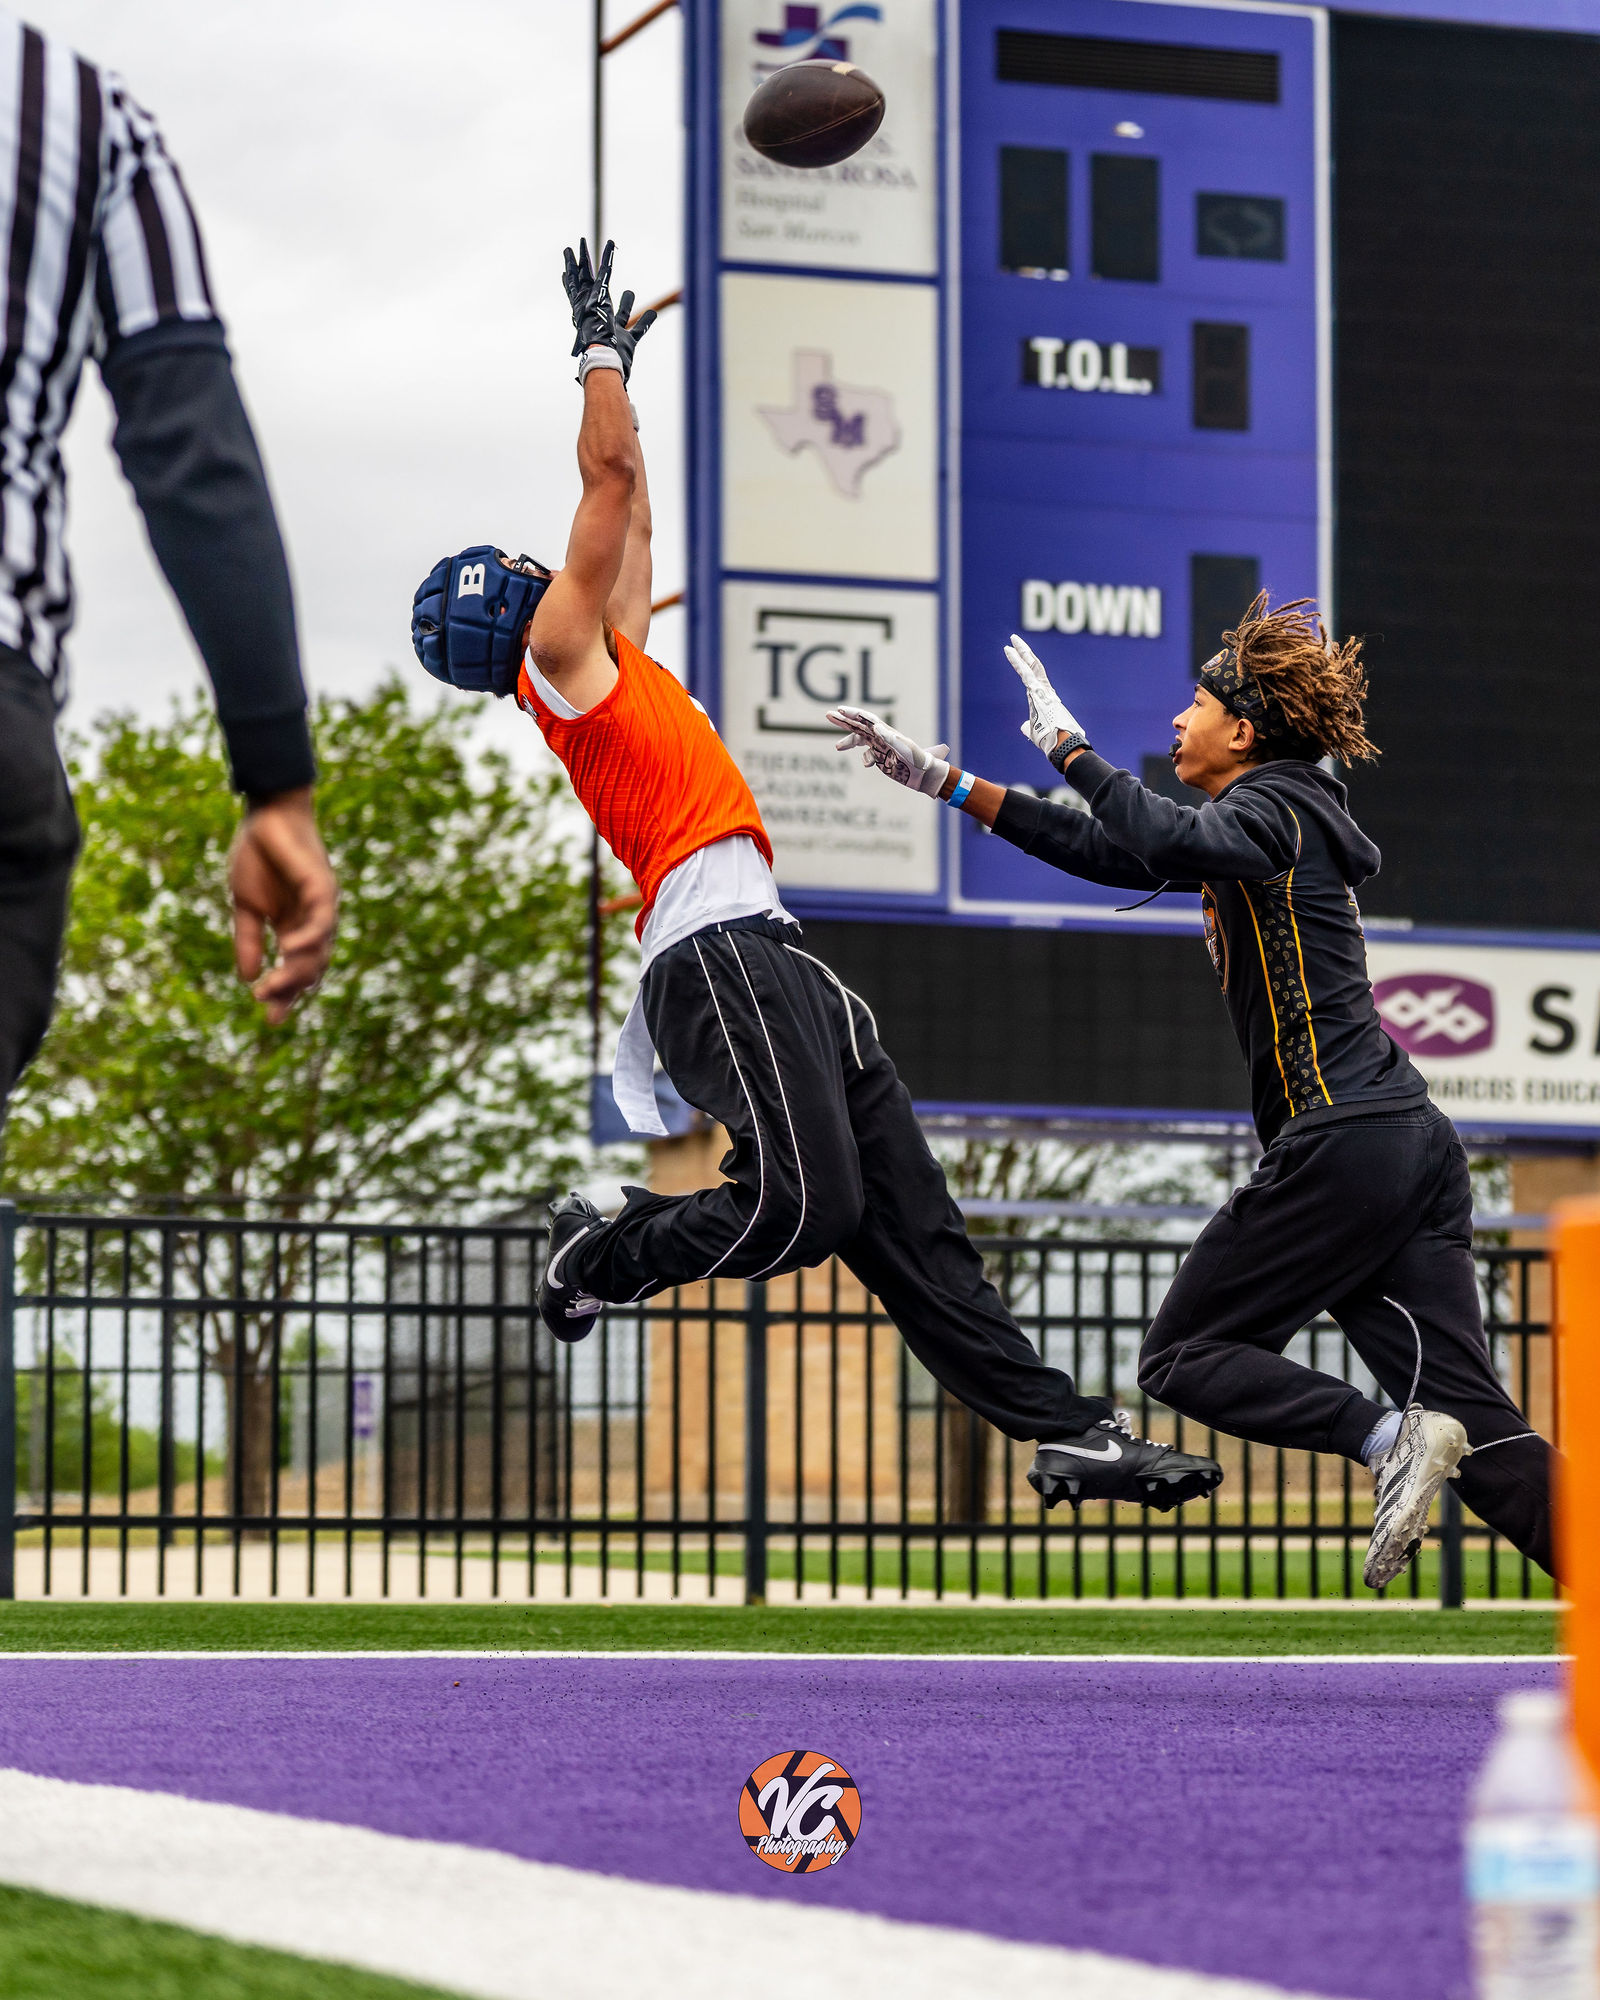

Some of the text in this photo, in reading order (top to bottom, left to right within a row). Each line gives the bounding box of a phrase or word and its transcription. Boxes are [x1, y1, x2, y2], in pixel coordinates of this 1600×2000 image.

[1030, 337, 1152, 395] T.O.L.
[457, 563, 485, 599] B
[1022, 580, 1161, 638] DOWN
[753, 643, 895, 705] TGL
